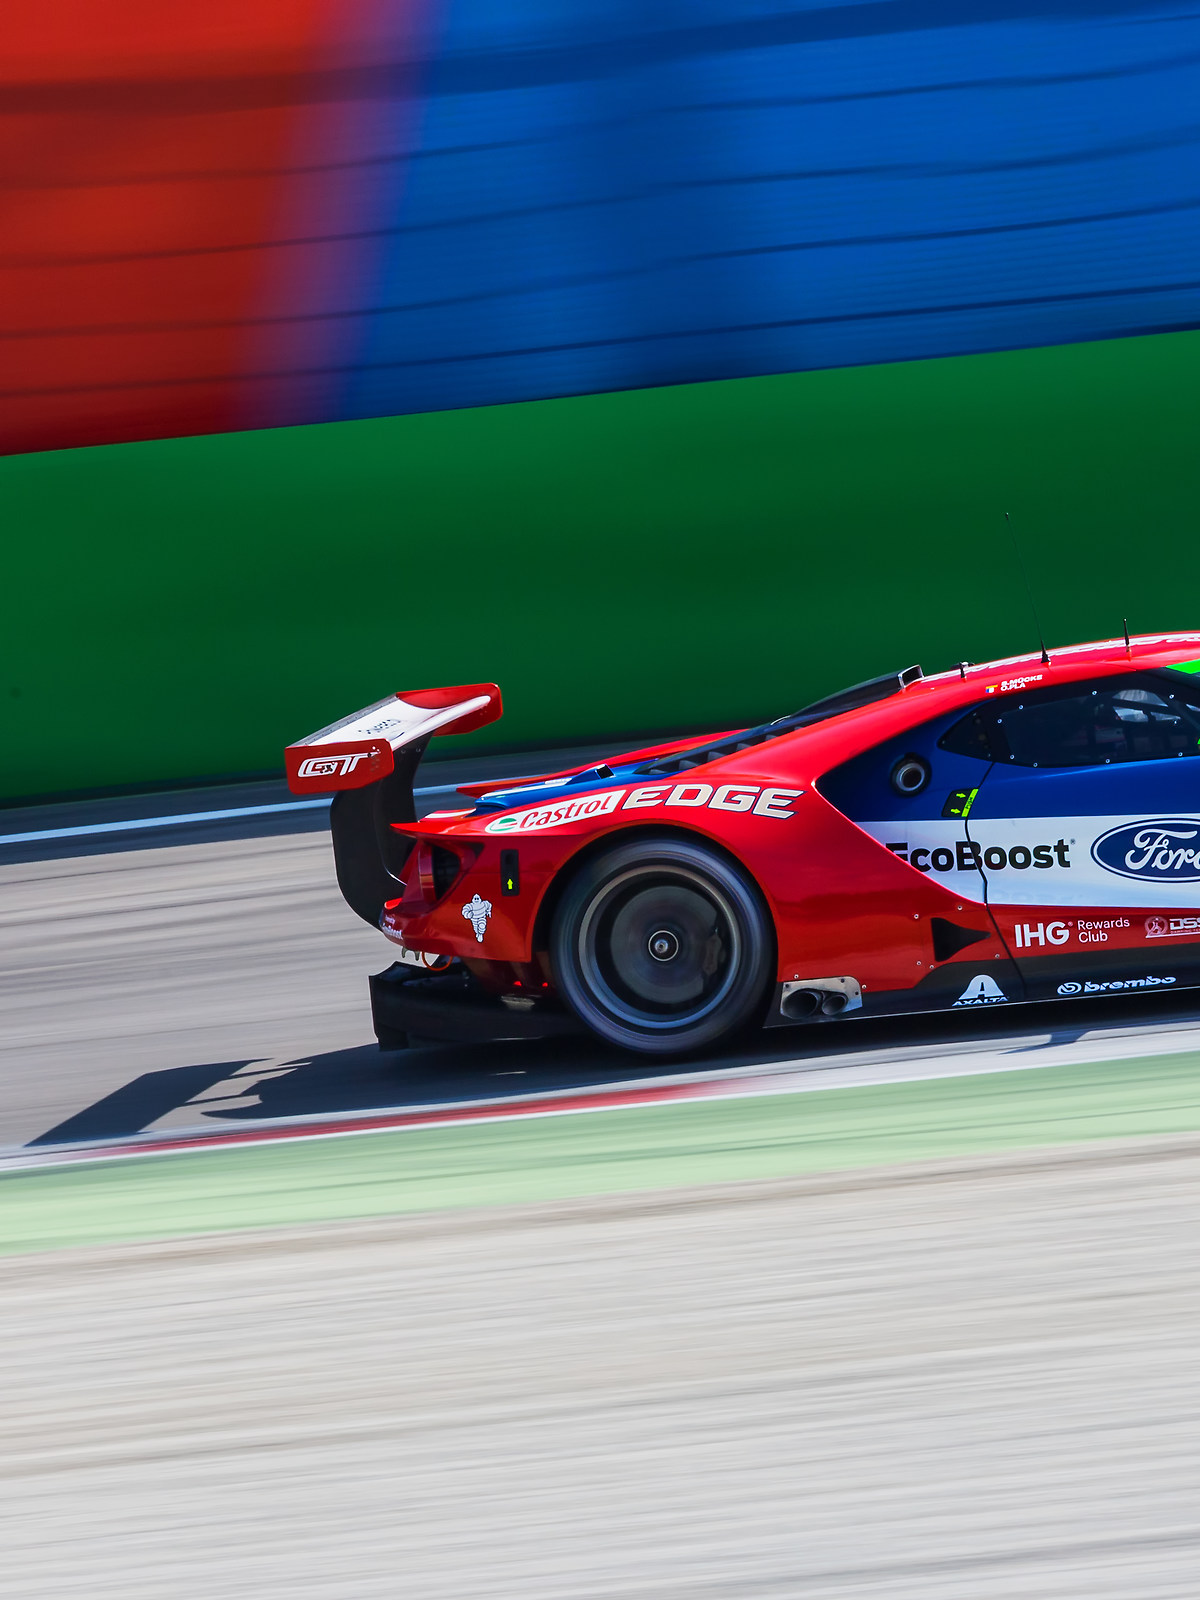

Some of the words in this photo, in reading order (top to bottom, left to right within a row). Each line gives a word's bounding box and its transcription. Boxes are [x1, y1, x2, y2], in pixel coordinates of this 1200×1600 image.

[298, 750, 382, 778] GT
[519, 795, 612, 829] Castrol
[621, 783, 806, 820] EDGE
[1077, 917, 1131, 931] Rewards
[1014, 920, 1070, 948] IHG
[1078, 931, 1108, 944] Club
[1083, 976, 1177, 993] brembo
[951, 996, 1009, 1007] AXALTA
